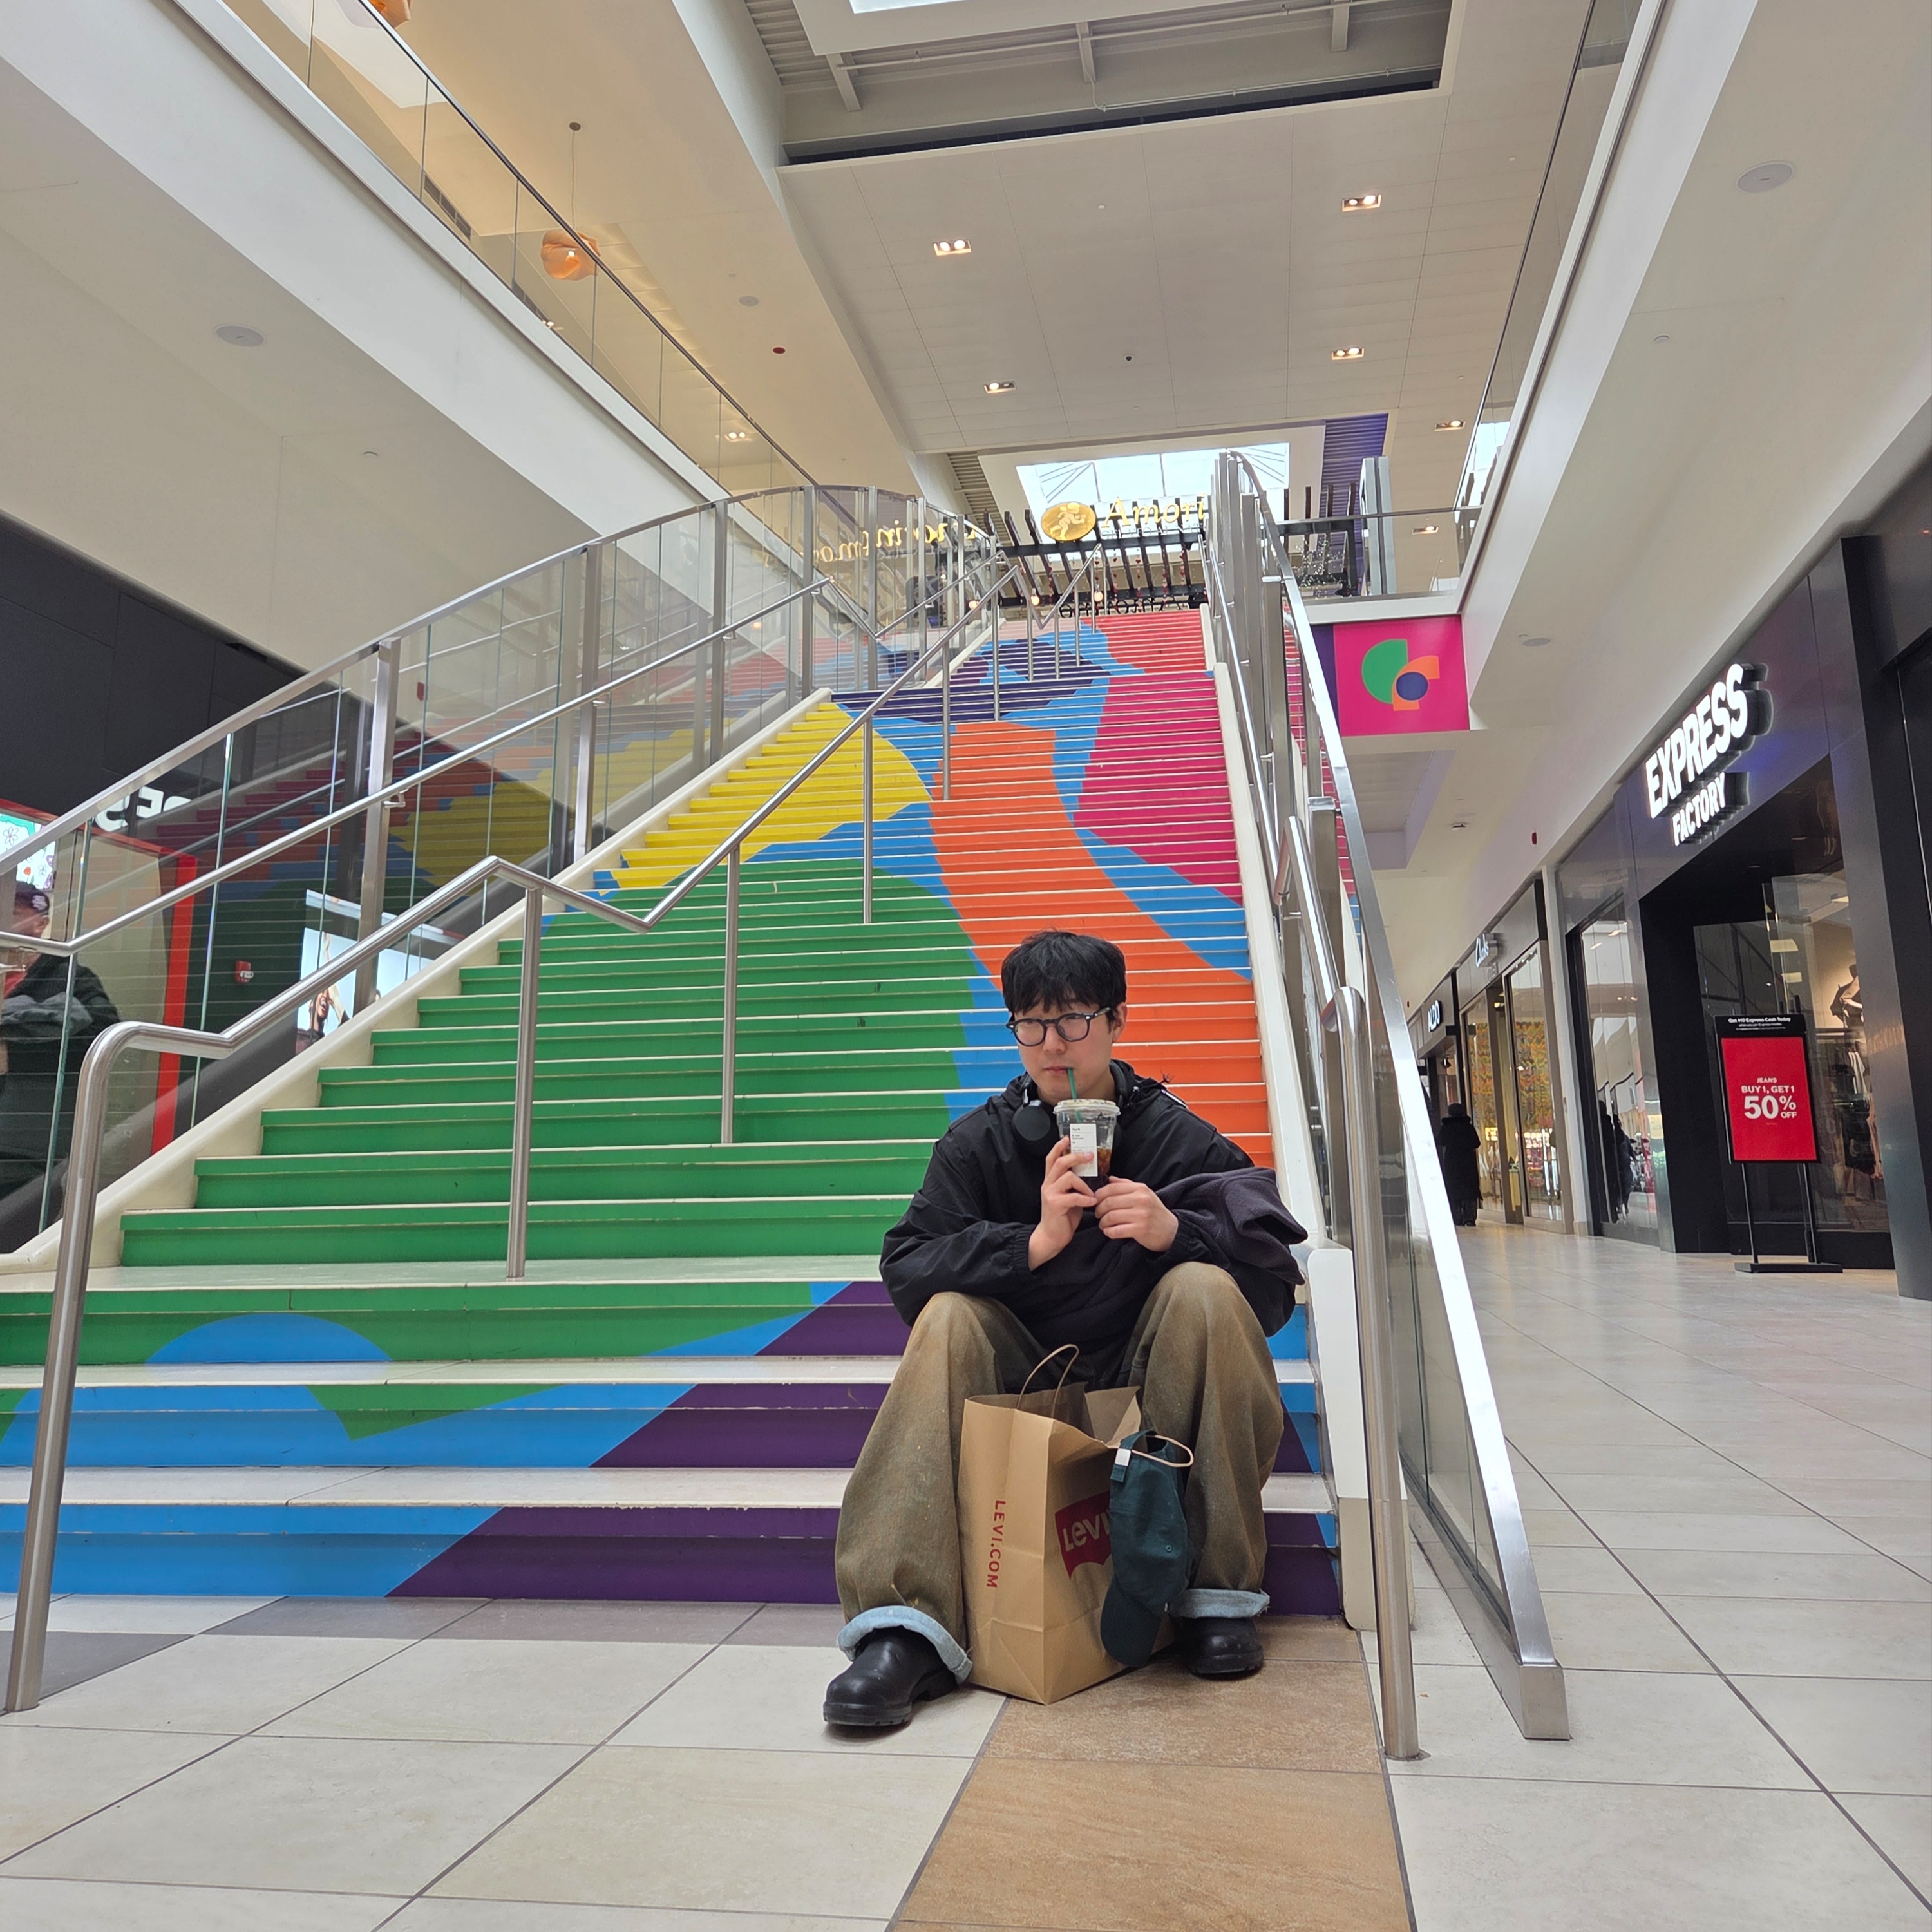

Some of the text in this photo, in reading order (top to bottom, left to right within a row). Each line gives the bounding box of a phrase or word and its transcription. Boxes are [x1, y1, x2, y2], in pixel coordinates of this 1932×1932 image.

[1645, 663, 1748, 819] EXPRESS
[1672, 772, 1726, 847] FACTORY
[1744, 1095, 1797, 1119] 50%
[1762, 1086, 1770, 1094] 1,
[986, 1499, 1006, 1589] LEVI.COM
